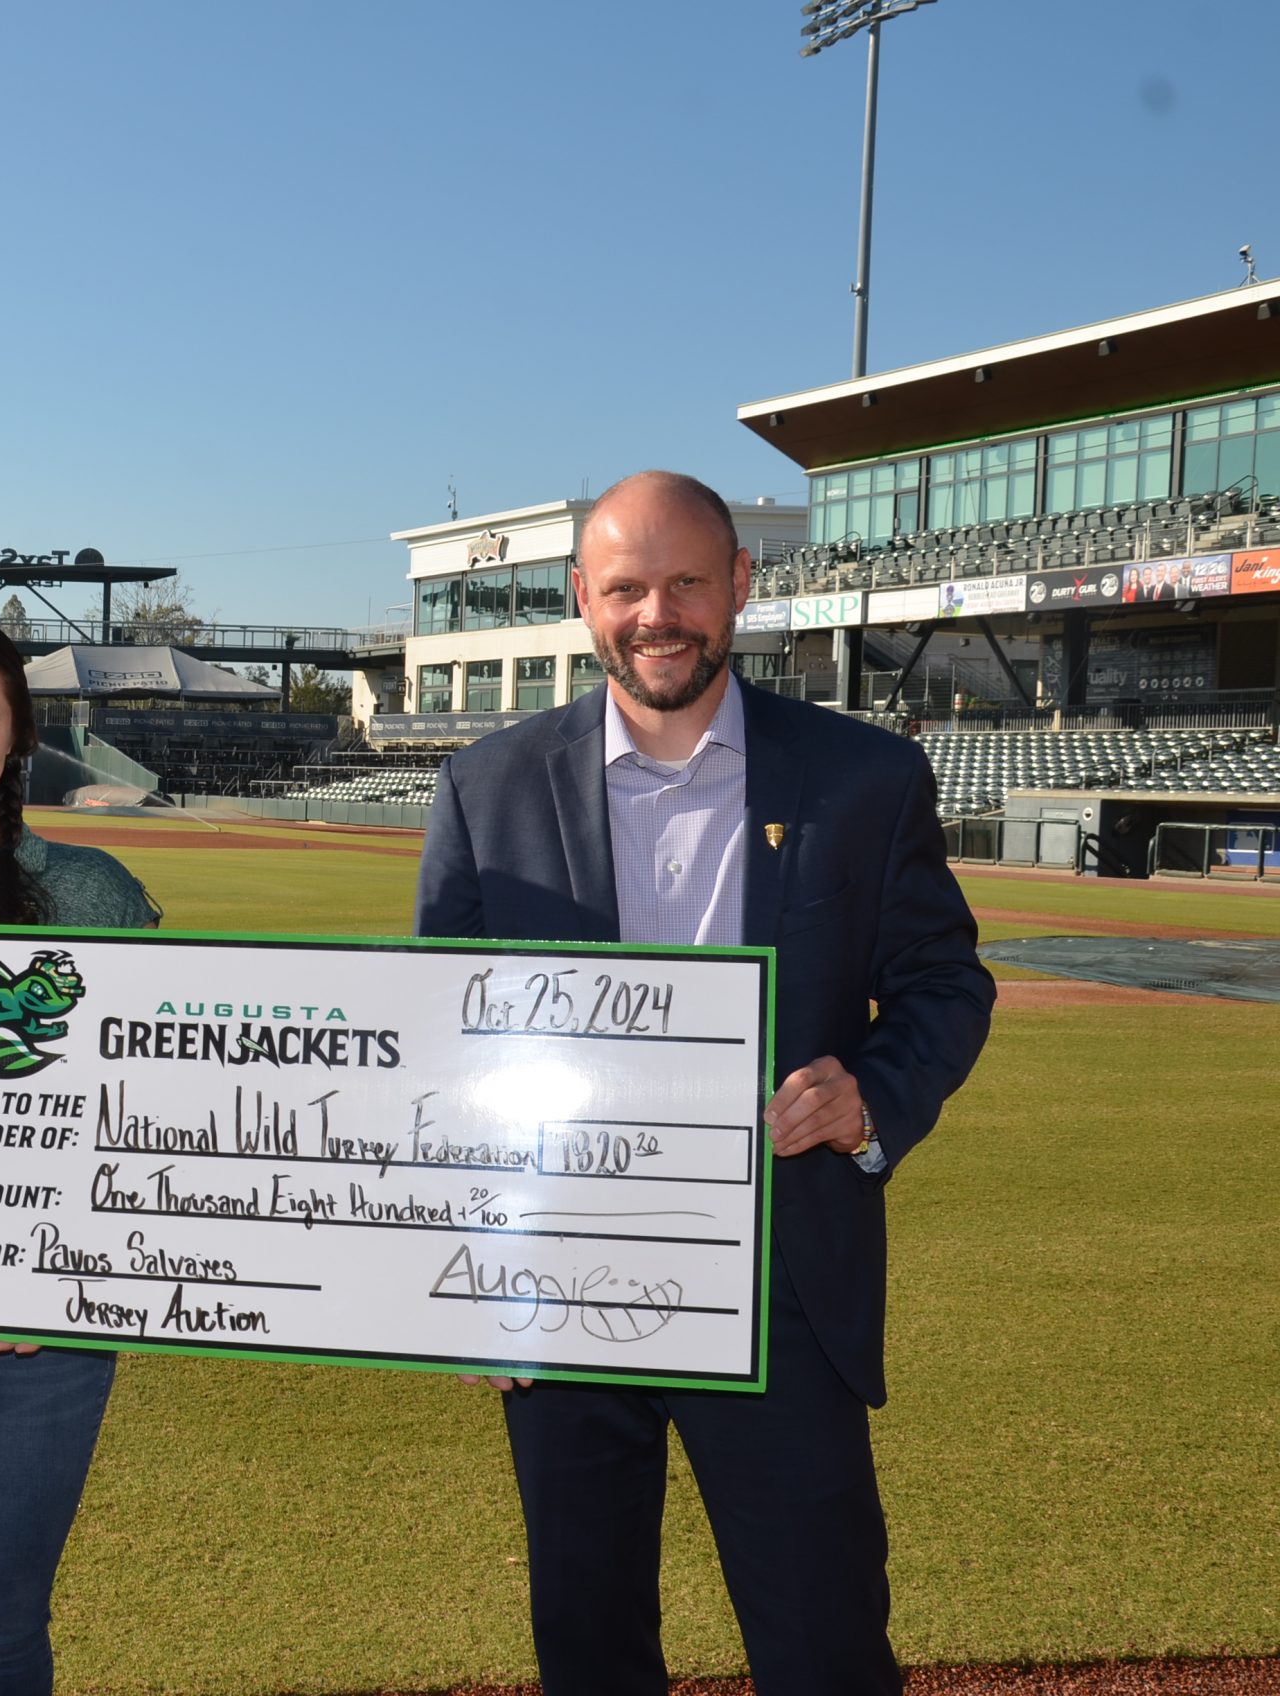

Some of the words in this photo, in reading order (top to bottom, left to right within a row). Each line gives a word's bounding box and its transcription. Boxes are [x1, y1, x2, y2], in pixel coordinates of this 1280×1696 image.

[963, 581, 989, 592] RONALD
[1051, 586, 1076, 597] DURTY
[1191, 582, 1228, 592] WEATHER
[793, 595, 859, 628] SRP
[155, 1000, 348, 1022] AUGUSTA
[461, 967, 517, 1032] Oct
[99, 1016, 402, 1070] GREENJACKETS
[1, 1091, 33, 1116] TO
[37, 1093, 87, 1119] THE
[94, 1079, 219, 1153] National
[235, 1085, 298, 1156] Wild
[39, 1126, 81, 1151] OF:
[92, 1162, 146, 1211] One
[147, 1165, 261, 1217] Thousand
[270, 1174, 339, 1230] Eight
[30, 1222, 113, 1273] Pavos
[161, 1283, 270, 1334] Auction
